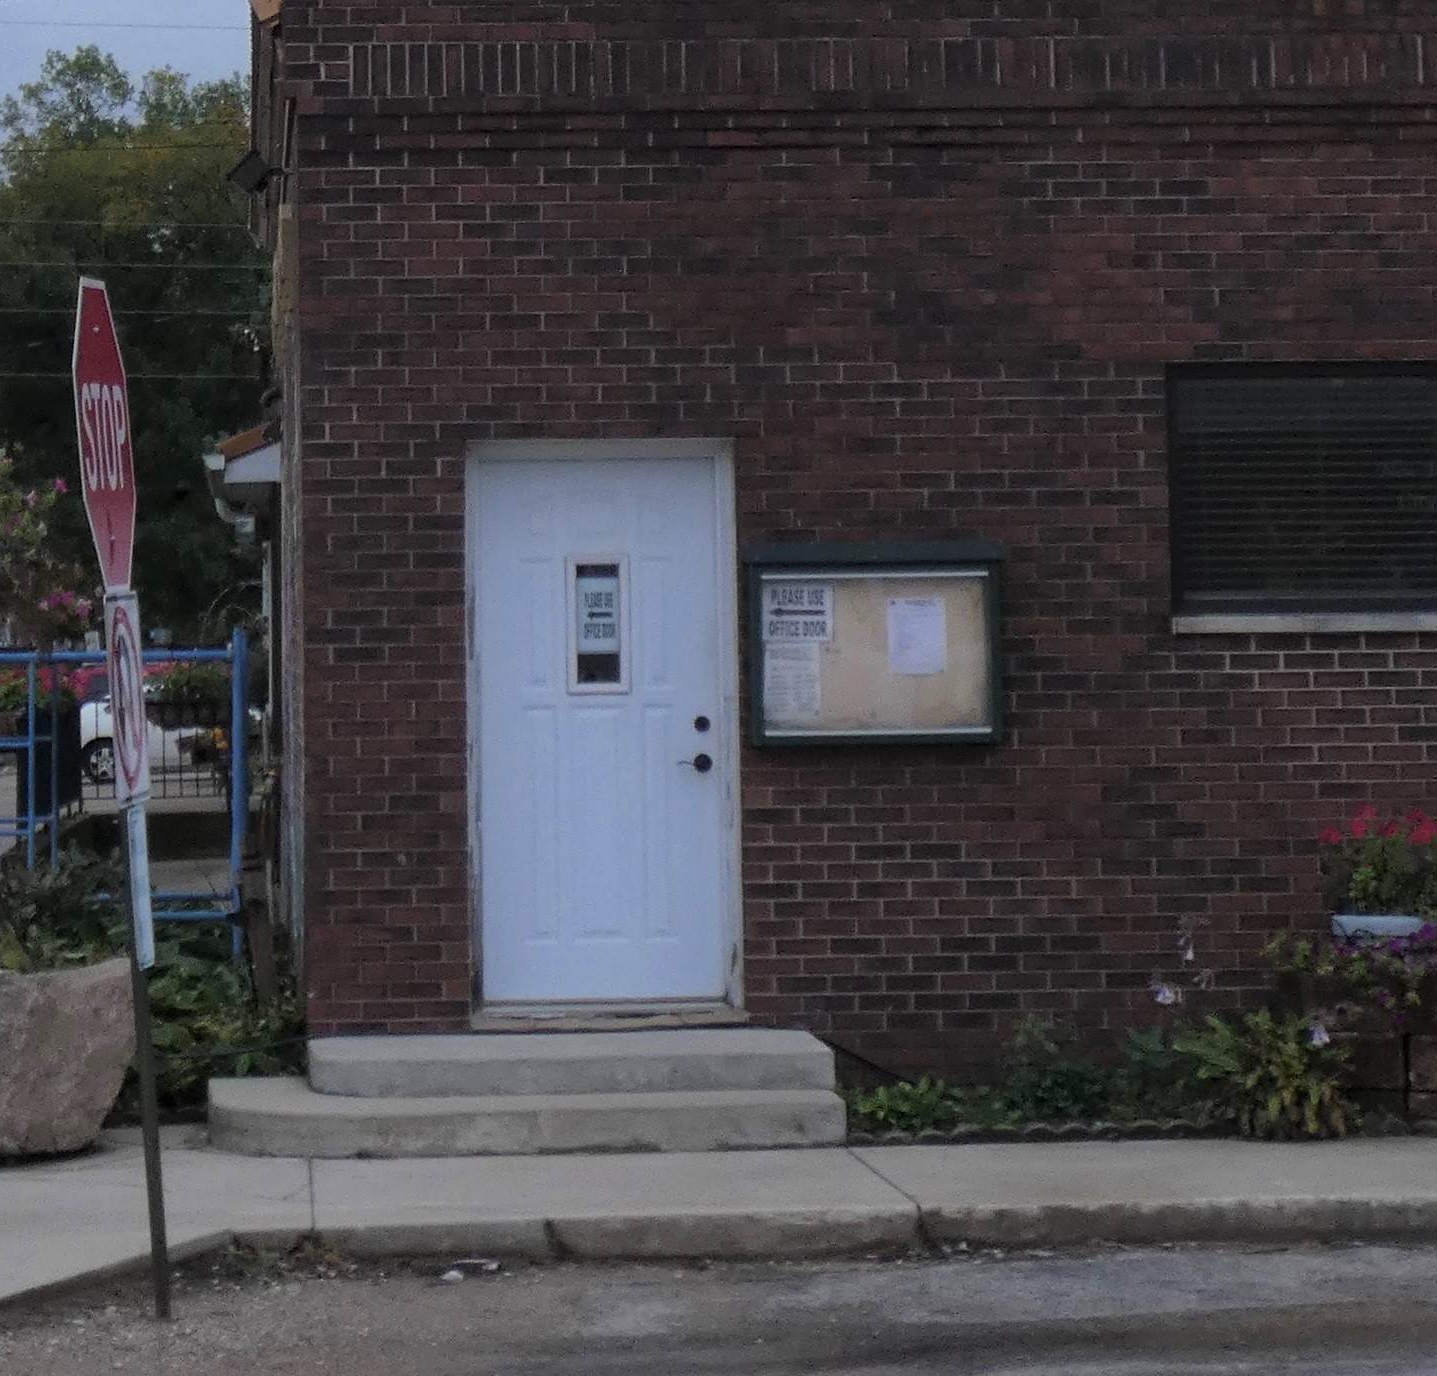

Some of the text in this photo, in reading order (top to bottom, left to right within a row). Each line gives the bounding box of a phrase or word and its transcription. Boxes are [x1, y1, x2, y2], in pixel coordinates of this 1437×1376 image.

[82, 382, 126, 491] STOP
[771, 588, 824, 606] PLEASE USE
[768, 620, 827, 637] OFFICE DOOR
